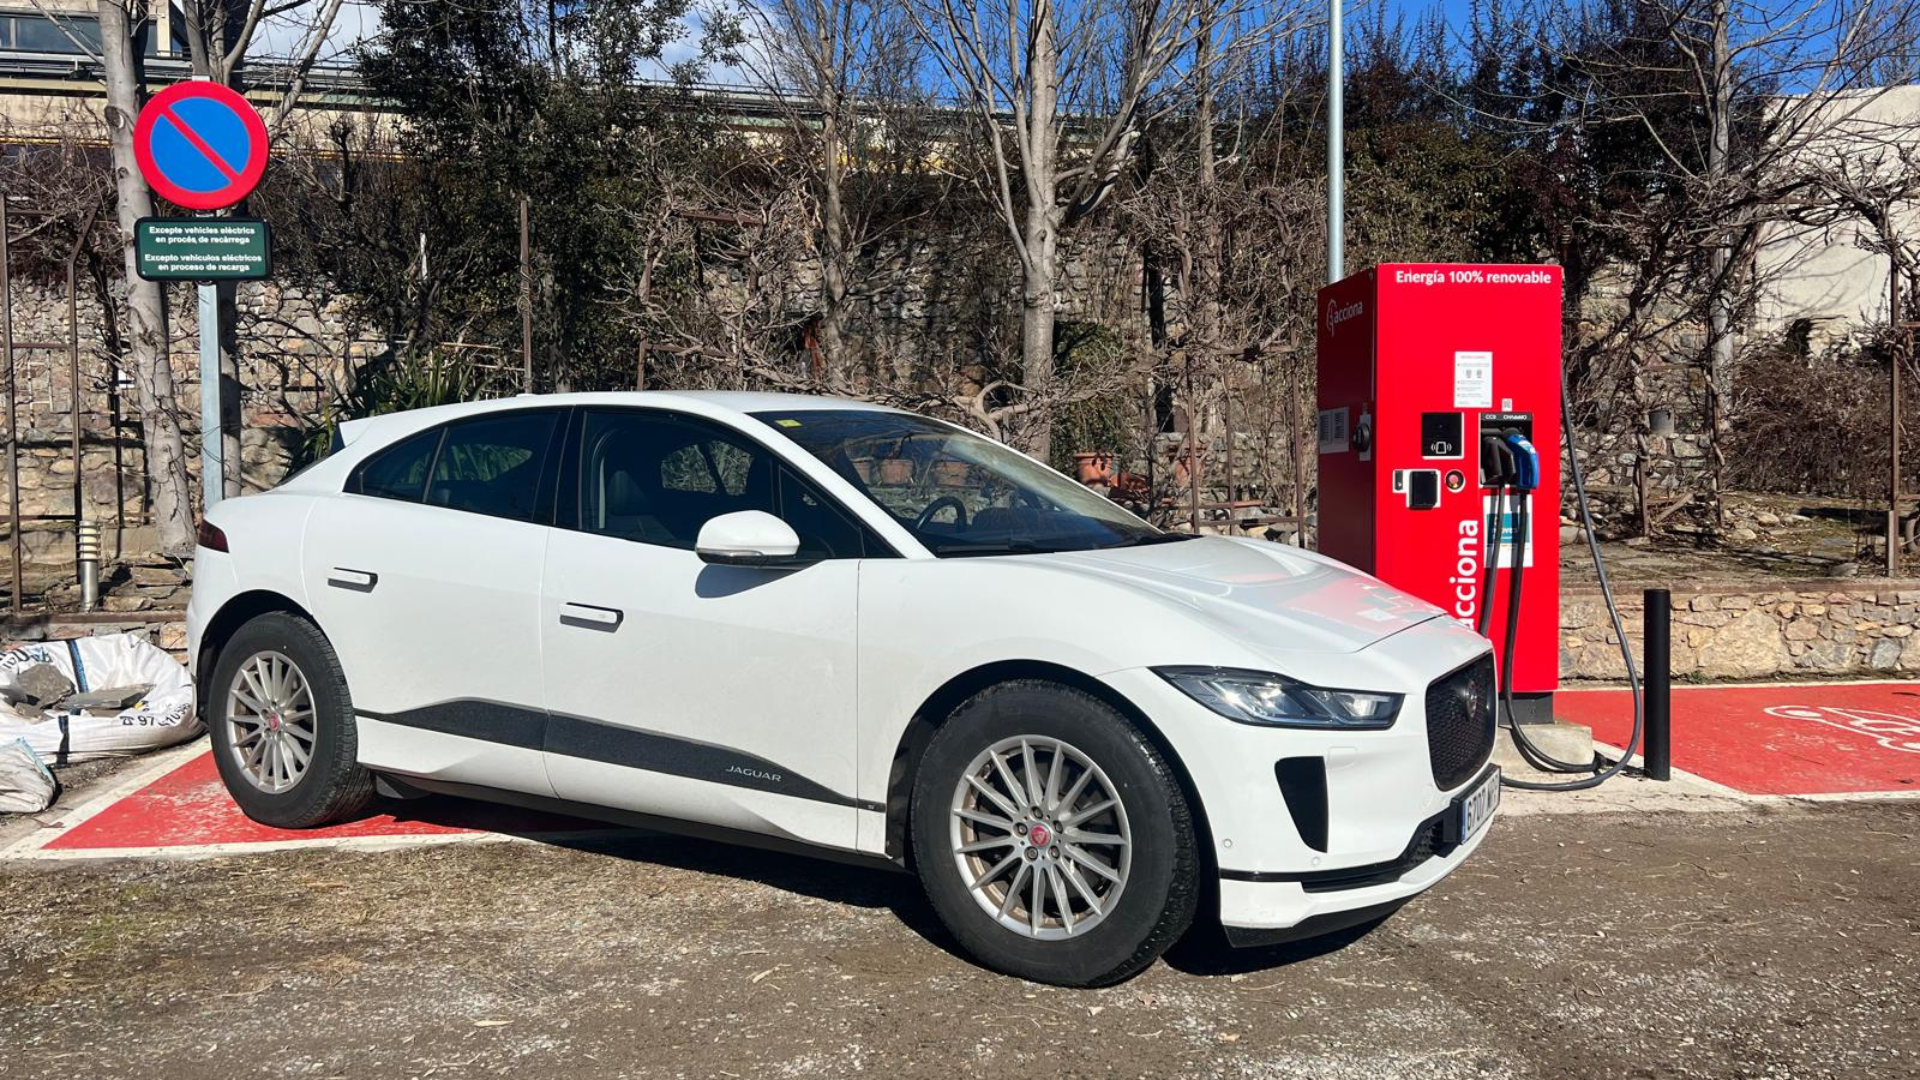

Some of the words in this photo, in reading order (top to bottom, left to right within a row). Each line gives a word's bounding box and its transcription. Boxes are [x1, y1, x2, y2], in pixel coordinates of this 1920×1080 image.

[149, 226, 183, 235] Excepte
[198, 235, 209, 243] de
[144, 254, 179, 263] Excepto
[170, 264, 204, 272] proceso
[205, 263, 217, 271] de
[218, 264, 250, 272] recarga
[1396, 269, 1445, 286] Energía
[1449, 270, 1483, 283] 100%
[1487, 270, 1551, 284] renovable
[1333, 301, 1364, 324] acciona
[725, 765, 782, 782] JAGUAR
